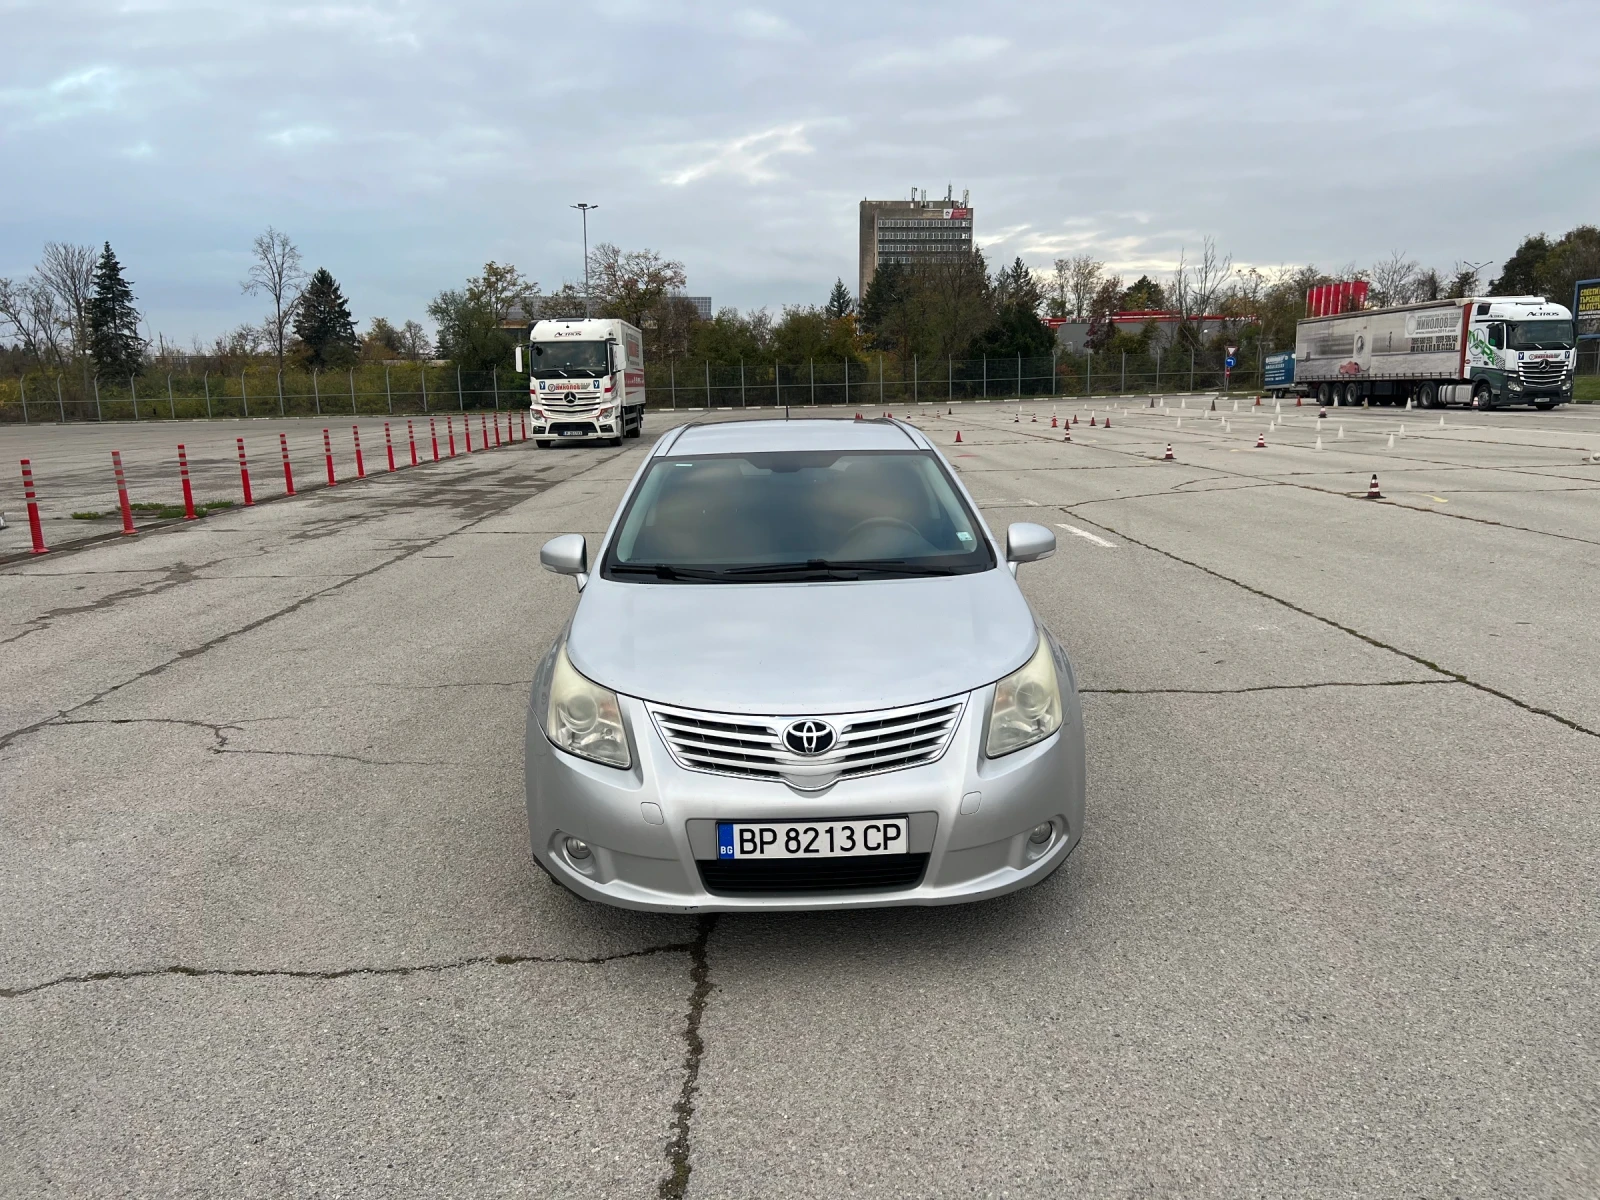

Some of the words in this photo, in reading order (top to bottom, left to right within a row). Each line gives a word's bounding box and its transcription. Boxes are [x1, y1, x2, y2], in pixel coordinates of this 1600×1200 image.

[1416, 317, 1449, 330] НИКОЛОВ
[739, 827, 778, 855] BP
[784, 825, 856, 854] 8213
[863, 823, 902, 852] CP
[720, 846, 733, 854] BG
